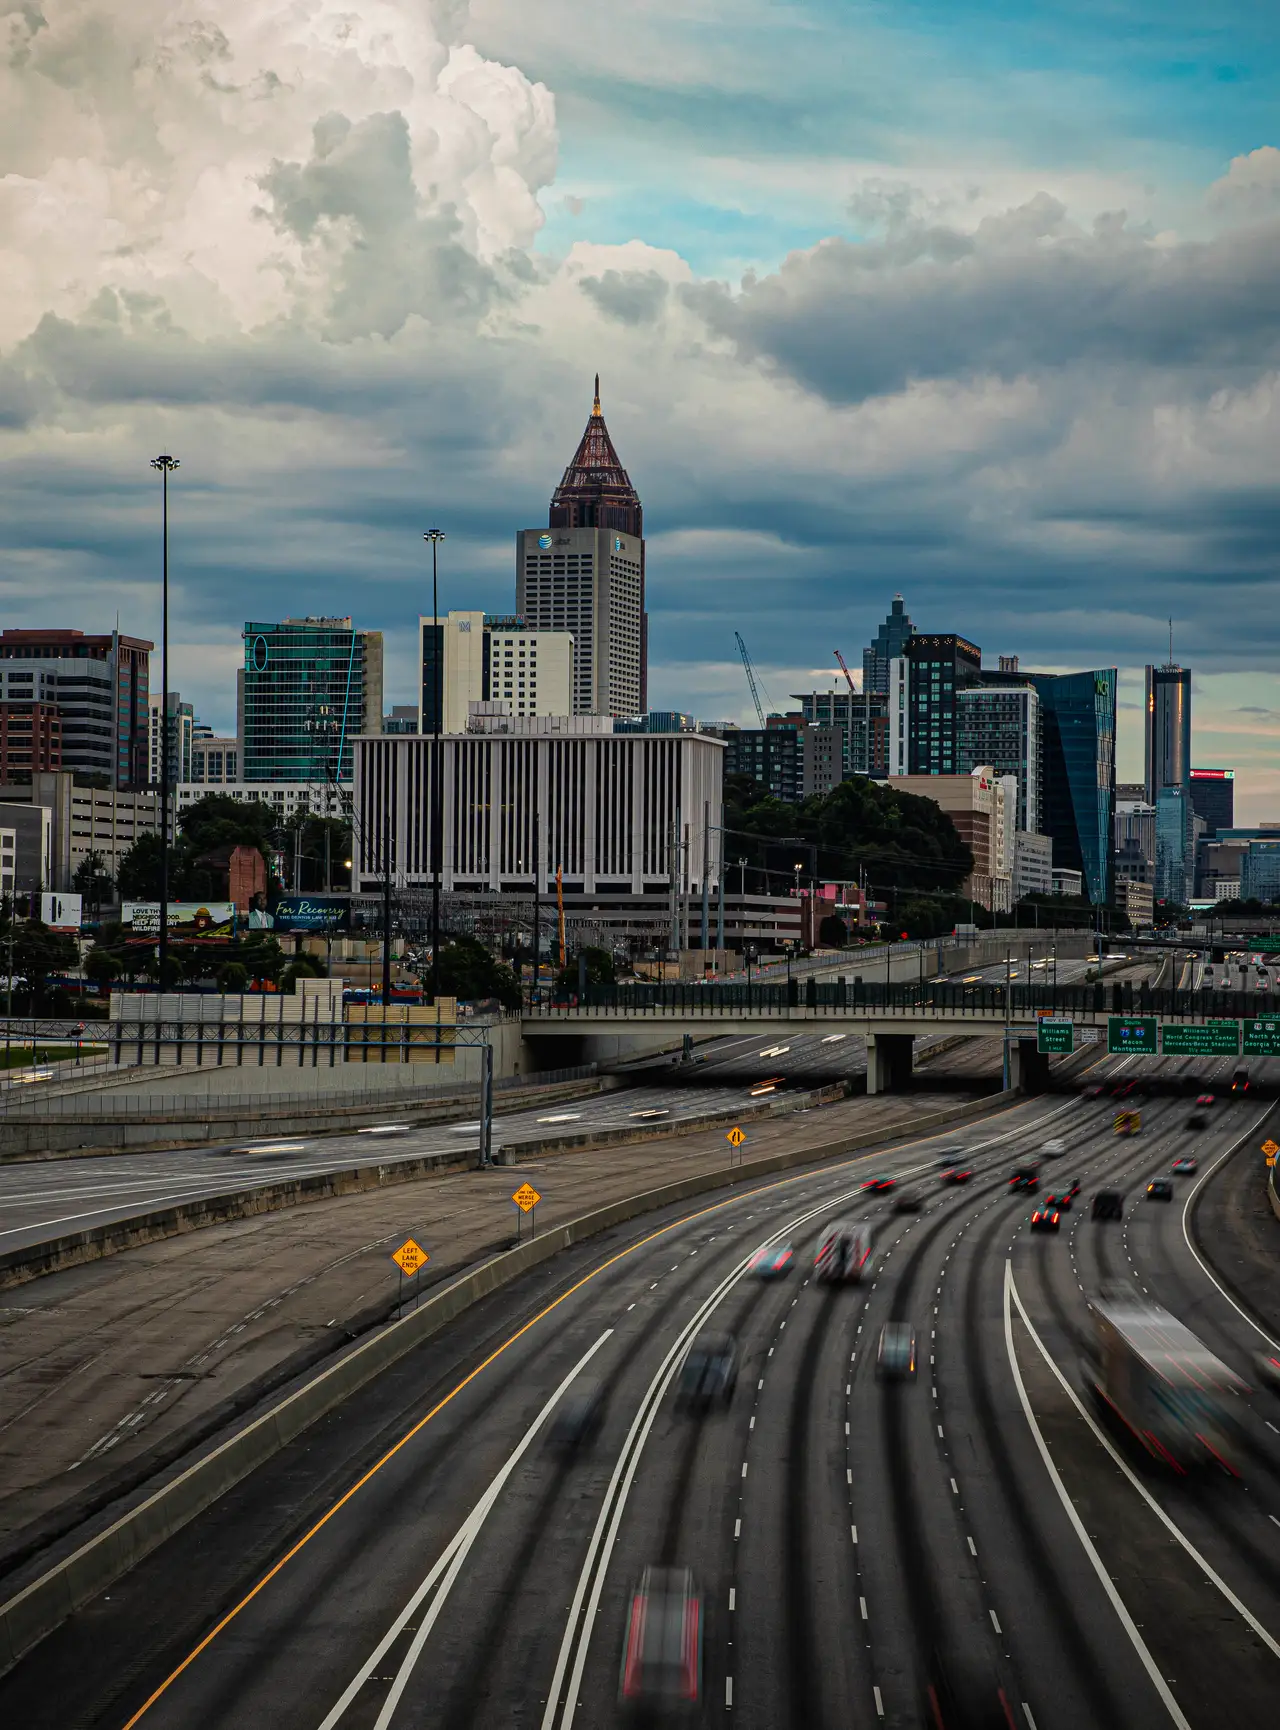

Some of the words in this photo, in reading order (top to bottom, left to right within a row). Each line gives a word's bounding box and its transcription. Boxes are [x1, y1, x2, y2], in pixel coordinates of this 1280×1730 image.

[1096, 679, 1110, 695] NCR
[275, 901, 296, 915] For
[297, 901, 347, 920] Recovery
[1120, 1029, 1130, 1037] 75
[1135, 1029, 1145, 1037] 85
[1244, 1040, 1270, 1049] Georgia
